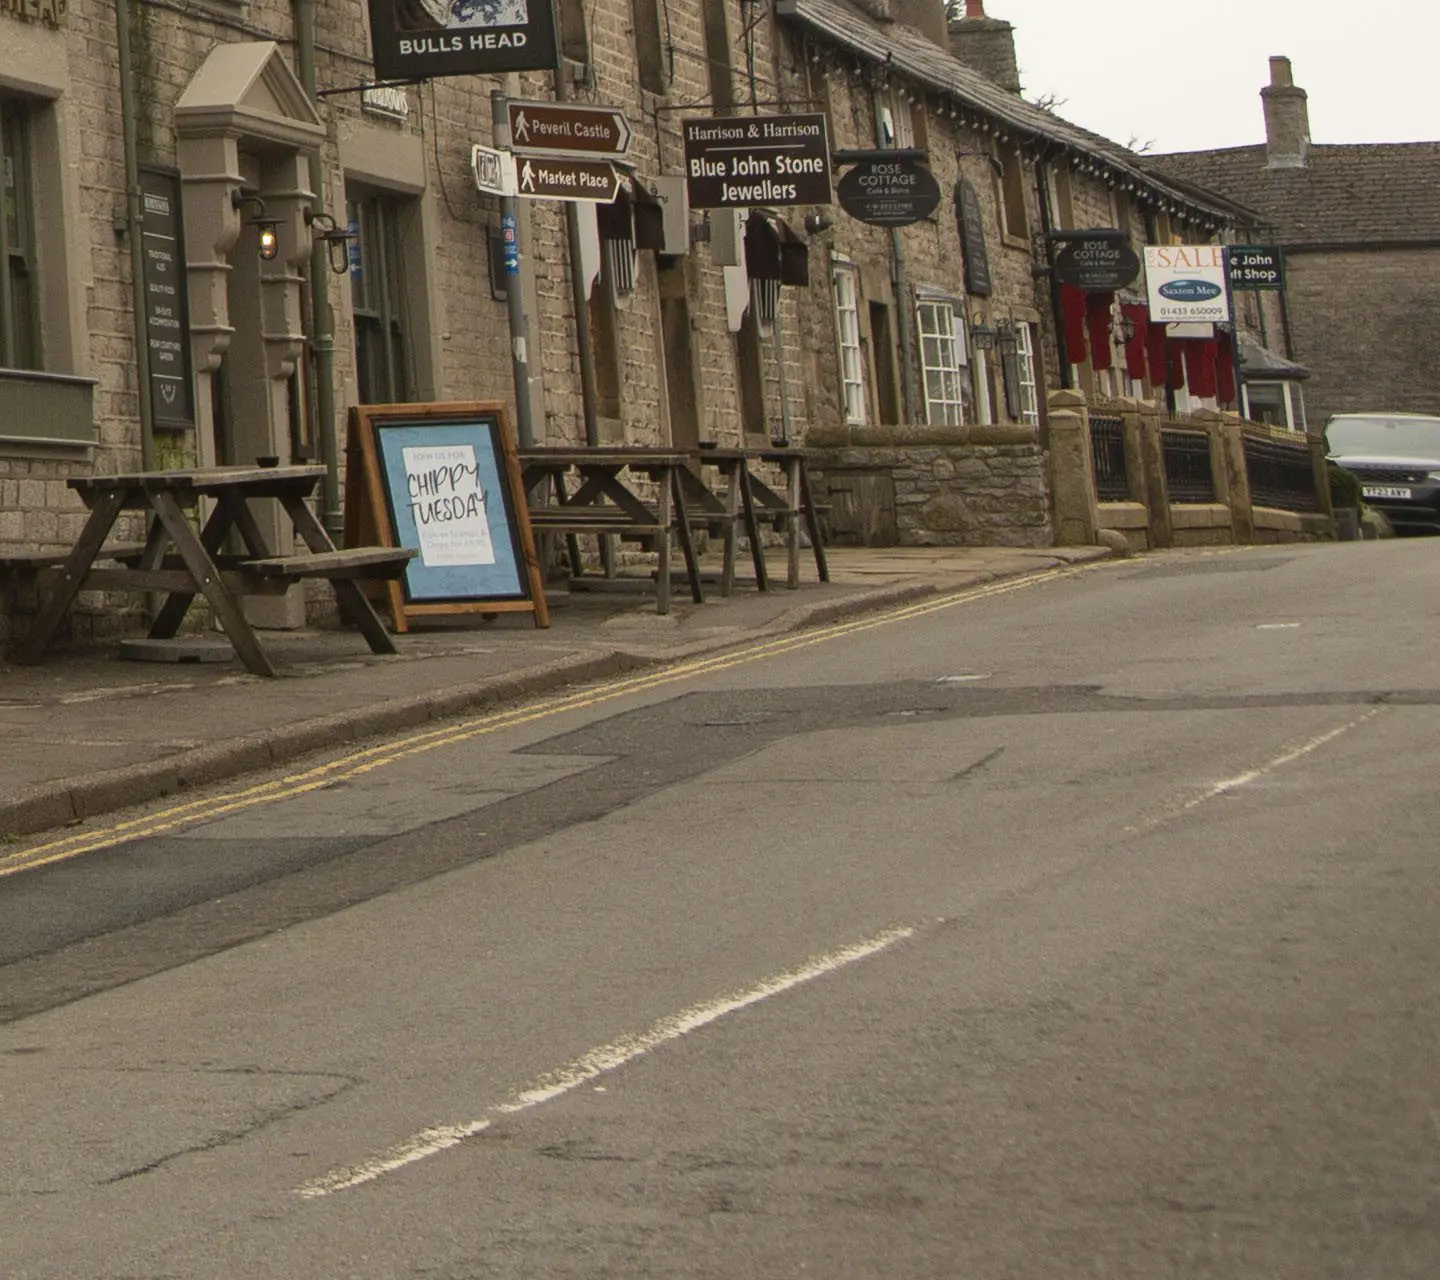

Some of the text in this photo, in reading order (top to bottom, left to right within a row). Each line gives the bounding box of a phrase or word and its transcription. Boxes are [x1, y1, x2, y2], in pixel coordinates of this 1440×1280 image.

[399, 32, 527, 54] BULLS HEAD
[532, 120, 610, 139] Peveril Castle
[689, 122, 820, 140] Harrison & Harrison
[690, 155, 823, 177] Blue John Stone
[871, 164, 902, 175] ROSE
[538, 169, 576, 186] Market
[579, 172, 608, 188] Place
[858, 174, 917, 186] COTTAGE
[721, 180, 797, 201] Jewellers
[1242, 254, 1273, 265] John
[1244, 268, 1277, 282] Shop
[407, 462, 480, 498] CHIPPY
[406, 490, 488, 527] TUESDAY
